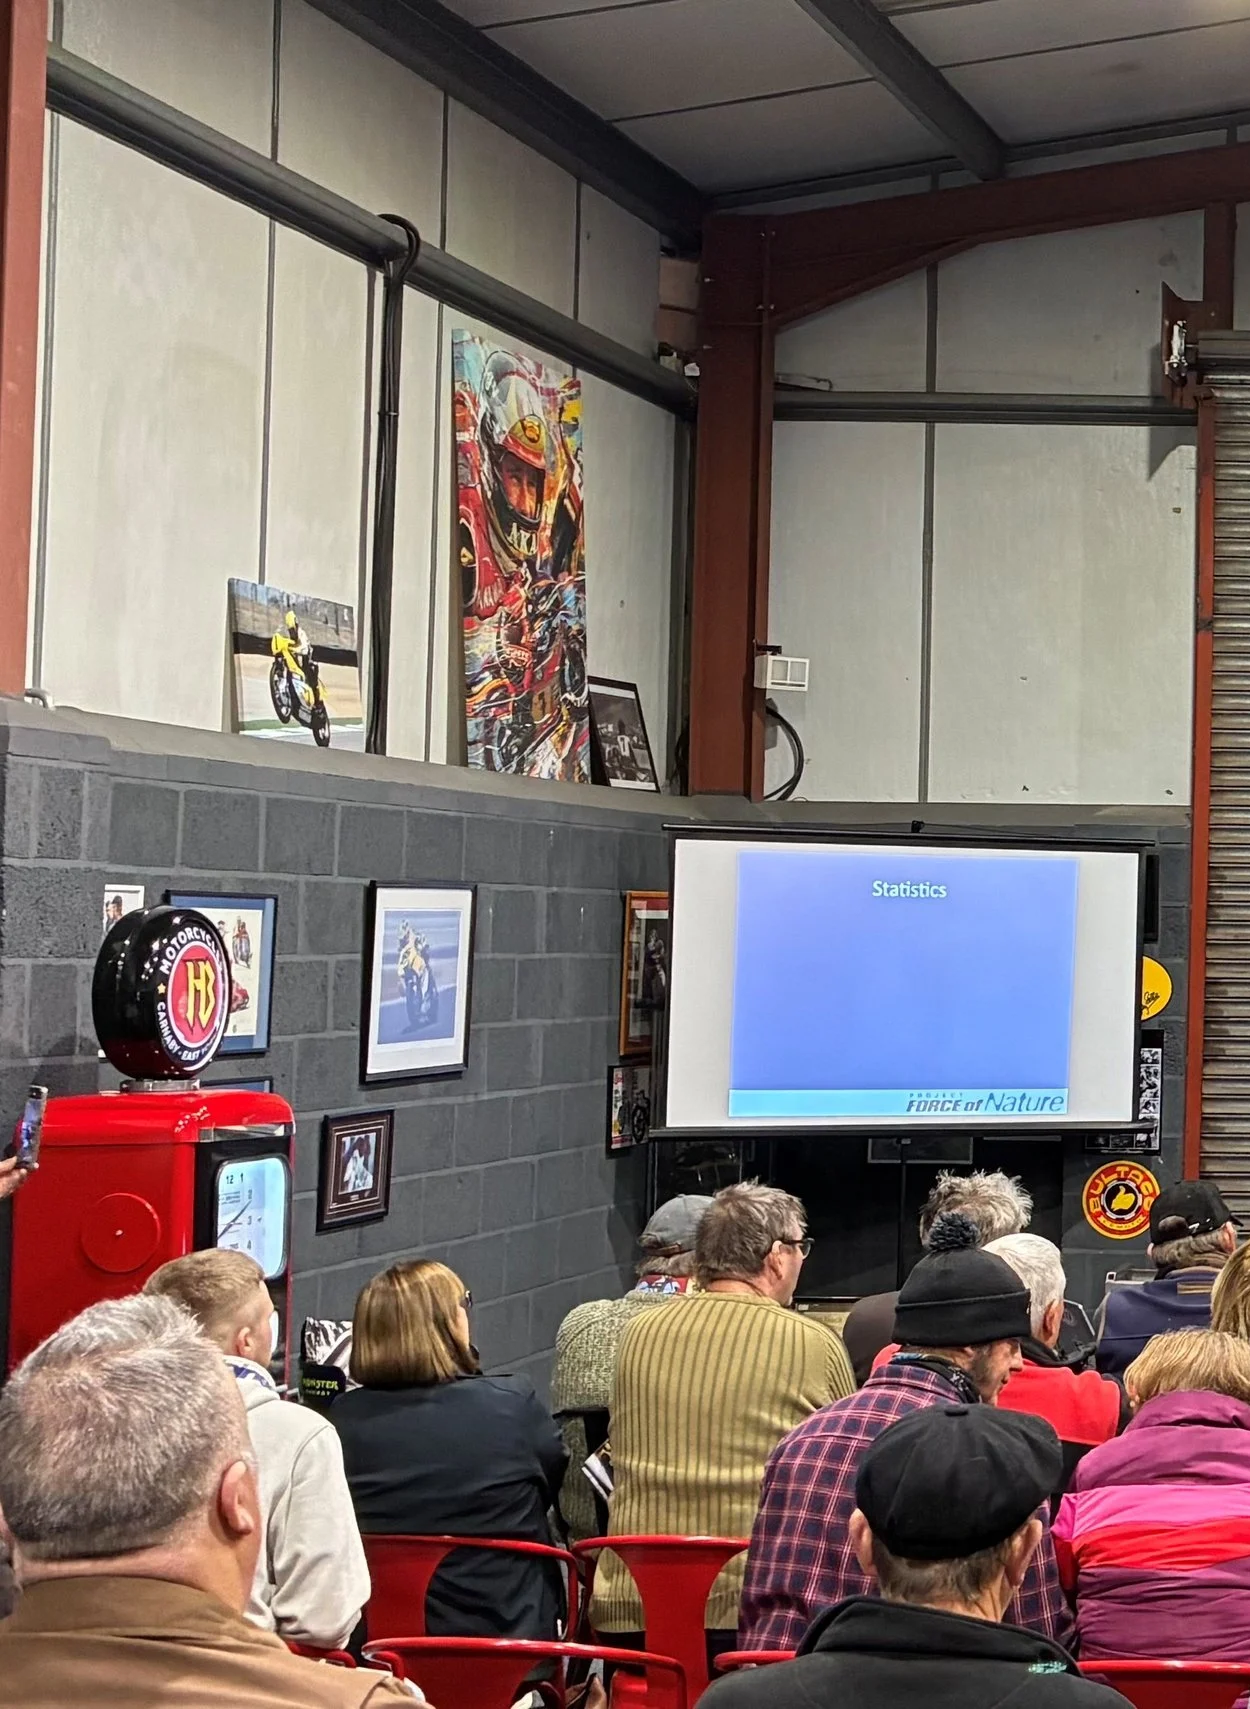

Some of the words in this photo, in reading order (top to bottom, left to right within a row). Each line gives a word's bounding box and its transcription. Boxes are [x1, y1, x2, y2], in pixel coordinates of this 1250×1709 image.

[872, 880, 947, 898] Statistics
[157, 1001, 181, 1054] CARNABY
[181, 1049, 200, 1061] EAST
[906, 1099, 961, 1112] FORCE
[963, 1099, 984, 1112] of
[984, 1092, 1065, 1112] Nature
[1089, 1166, 1155, 1213] BULTACO
